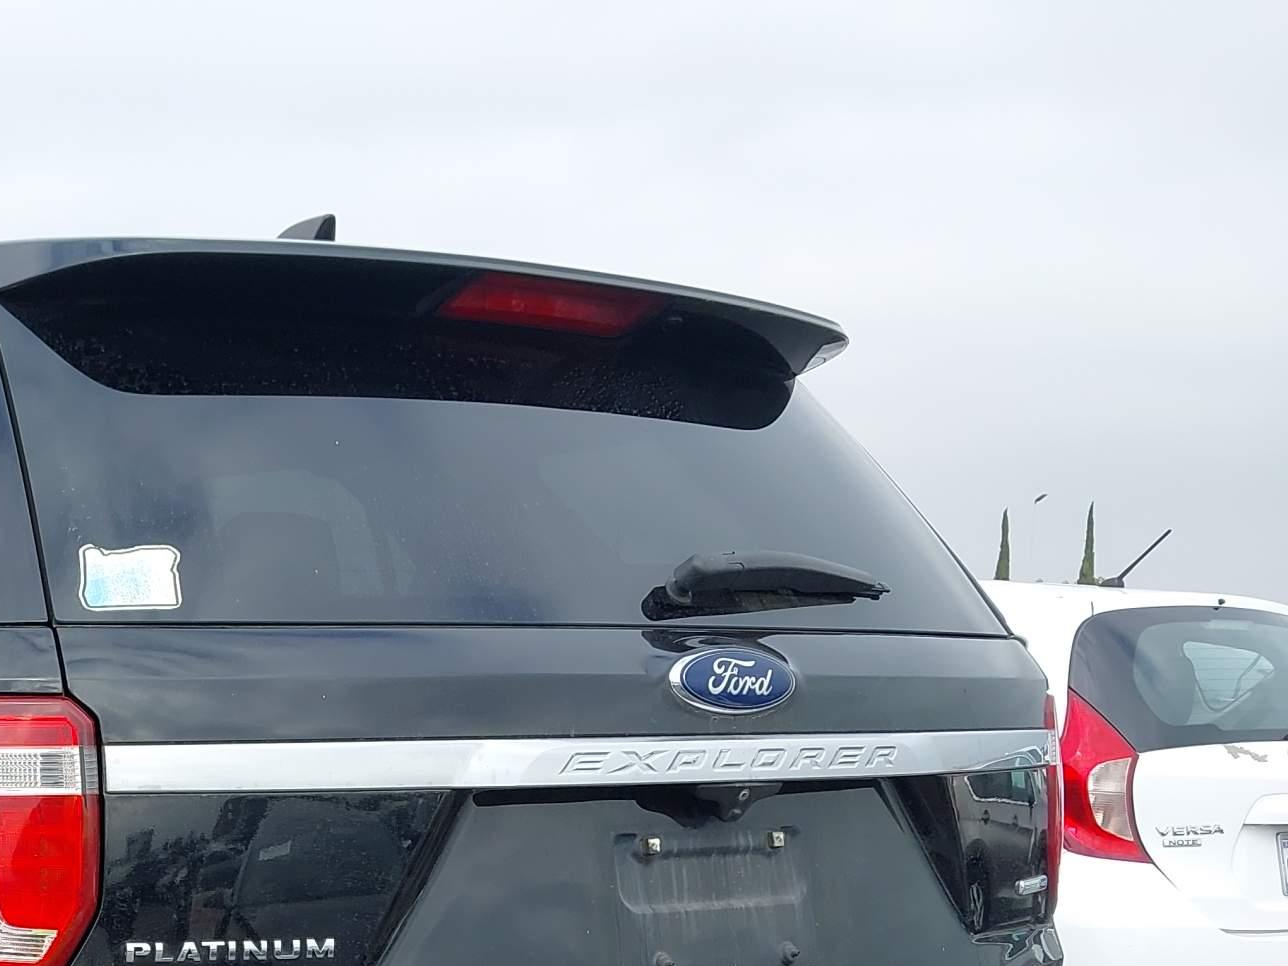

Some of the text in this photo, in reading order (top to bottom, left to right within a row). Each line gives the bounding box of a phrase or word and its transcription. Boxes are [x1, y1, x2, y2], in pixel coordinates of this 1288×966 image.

[708, 657, 773, 696] Ford
[558, 745, 898, 775] EXPLORER
[1155, 824, 1224, 836] VERSA
[1167, 839, 1200, 848] NOTE
[124, 938, 337, 963] PLATINUM
